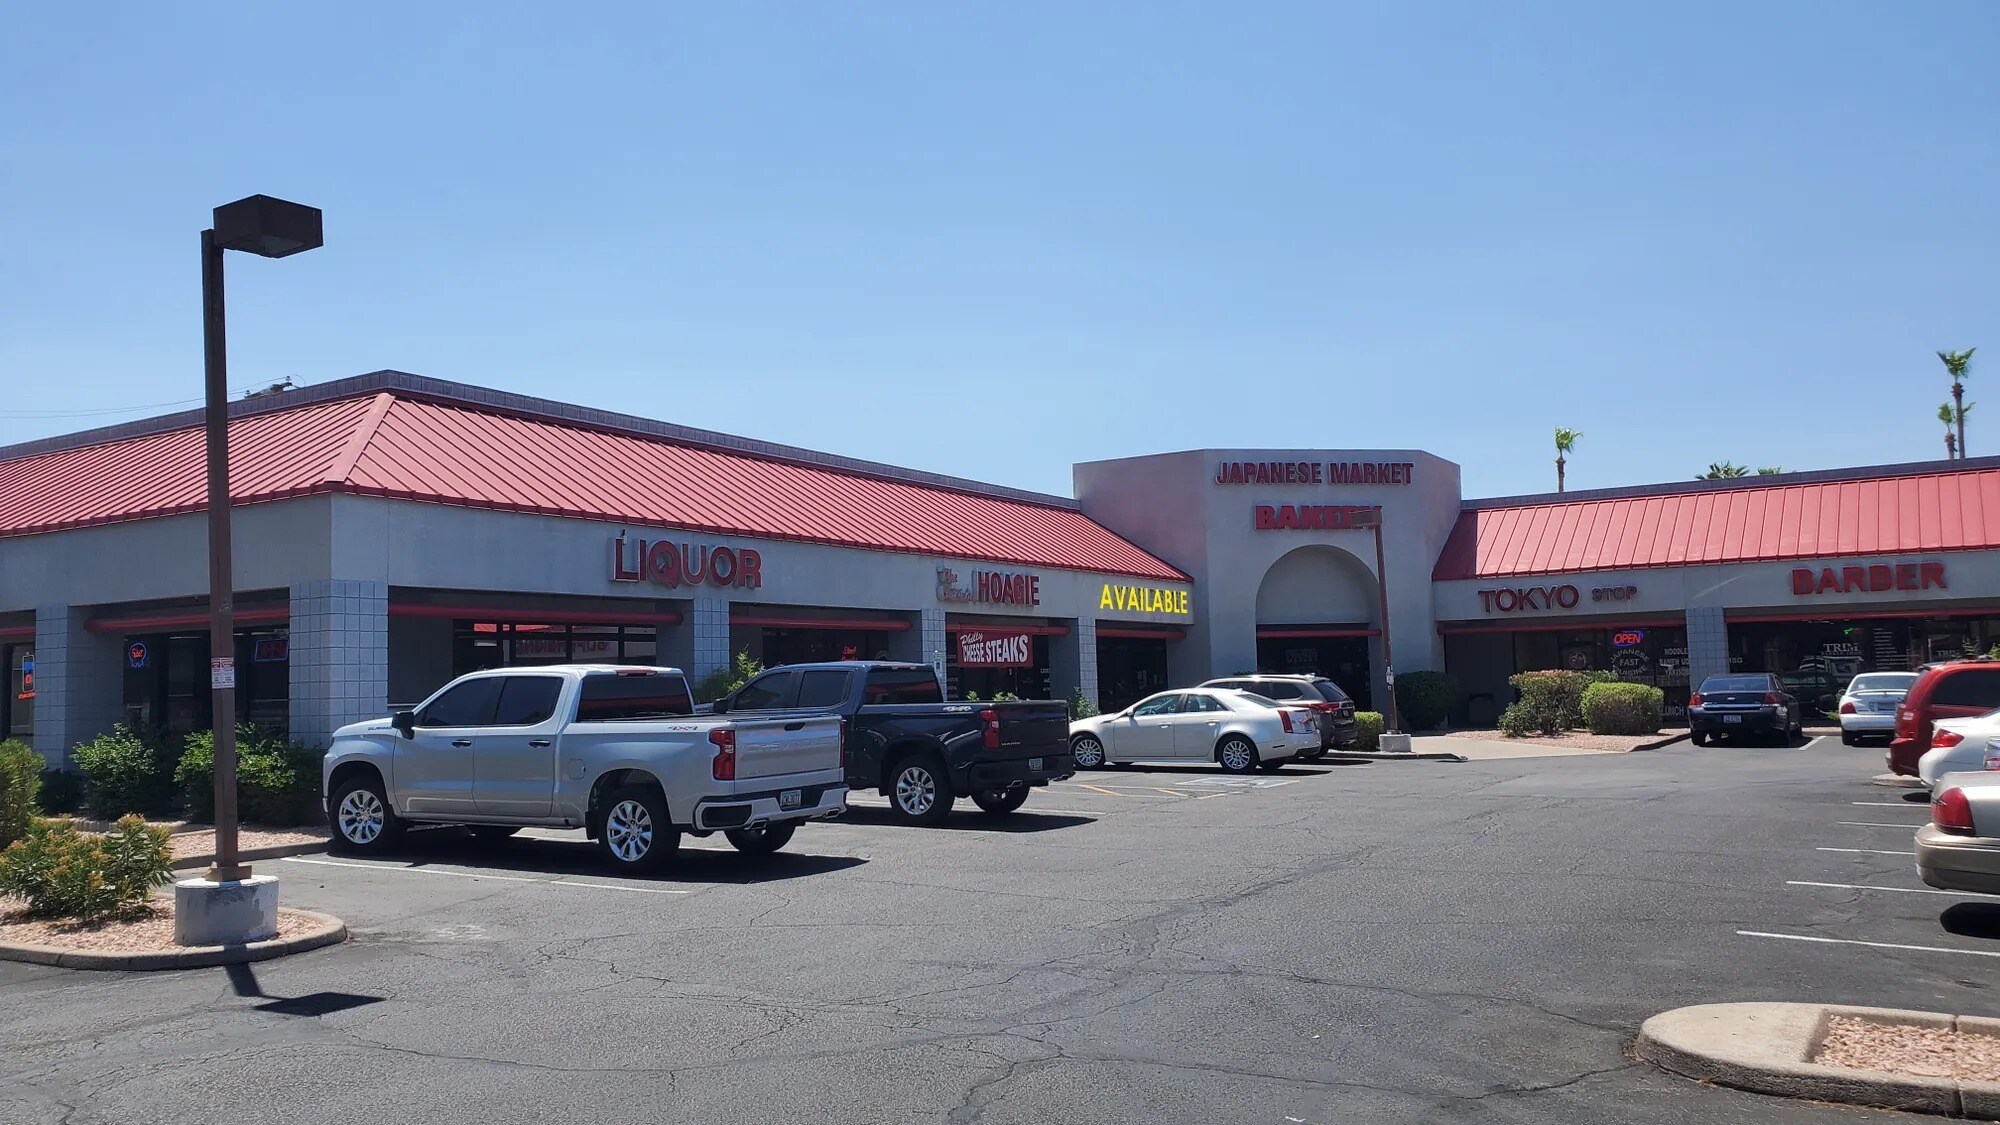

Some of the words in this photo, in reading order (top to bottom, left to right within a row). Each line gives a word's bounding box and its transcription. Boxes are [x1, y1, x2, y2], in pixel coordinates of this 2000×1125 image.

[1215, 461, 1323, 485] JAPANESE
[1329, 461, 1414, 485] MARKET
[611, 538, 762, 589] LIQUOR
[976, 570, 1041, 606] HOAGIE
[1792, 561, 1948, 595] BARBER
[1100, 583, 1189, 614] AVAILABLE
[1478, 584, 1580, 613] TOKYO
[1591, 585, 1638, 601] STOP
[960, 631, 984, 647] Philly
[962, 642, 985, 663] CHEESE
[986, 634, 1028, 663] STEAKS
[1613, 633, 1641, 644] OPEN
[1822, 643, 1860, 652] TRIM
[1610, 648, 1650, 663] JAPANESE
[1619, 658, 1640, 666] FAST
